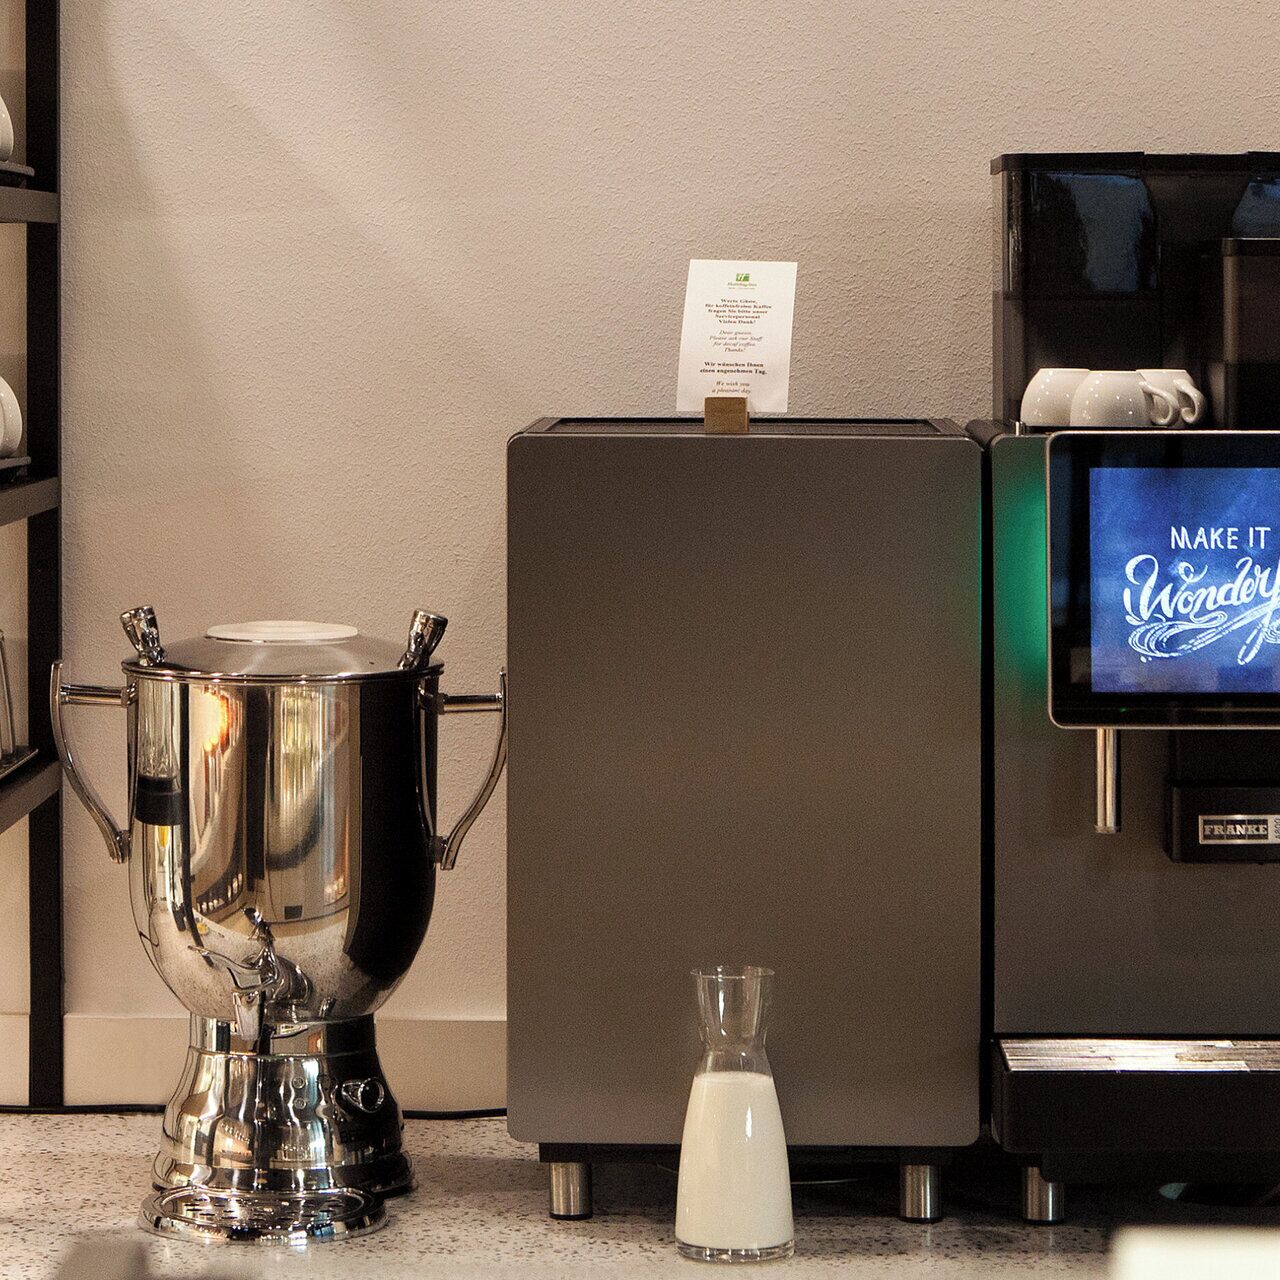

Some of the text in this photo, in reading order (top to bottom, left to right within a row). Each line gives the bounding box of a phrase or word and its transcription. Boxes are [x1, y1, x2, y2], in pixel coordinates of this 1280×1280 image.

[1170, 526, 1271, 550] MAKE IT
[1203, 823, 1268, 836] FRANKE
